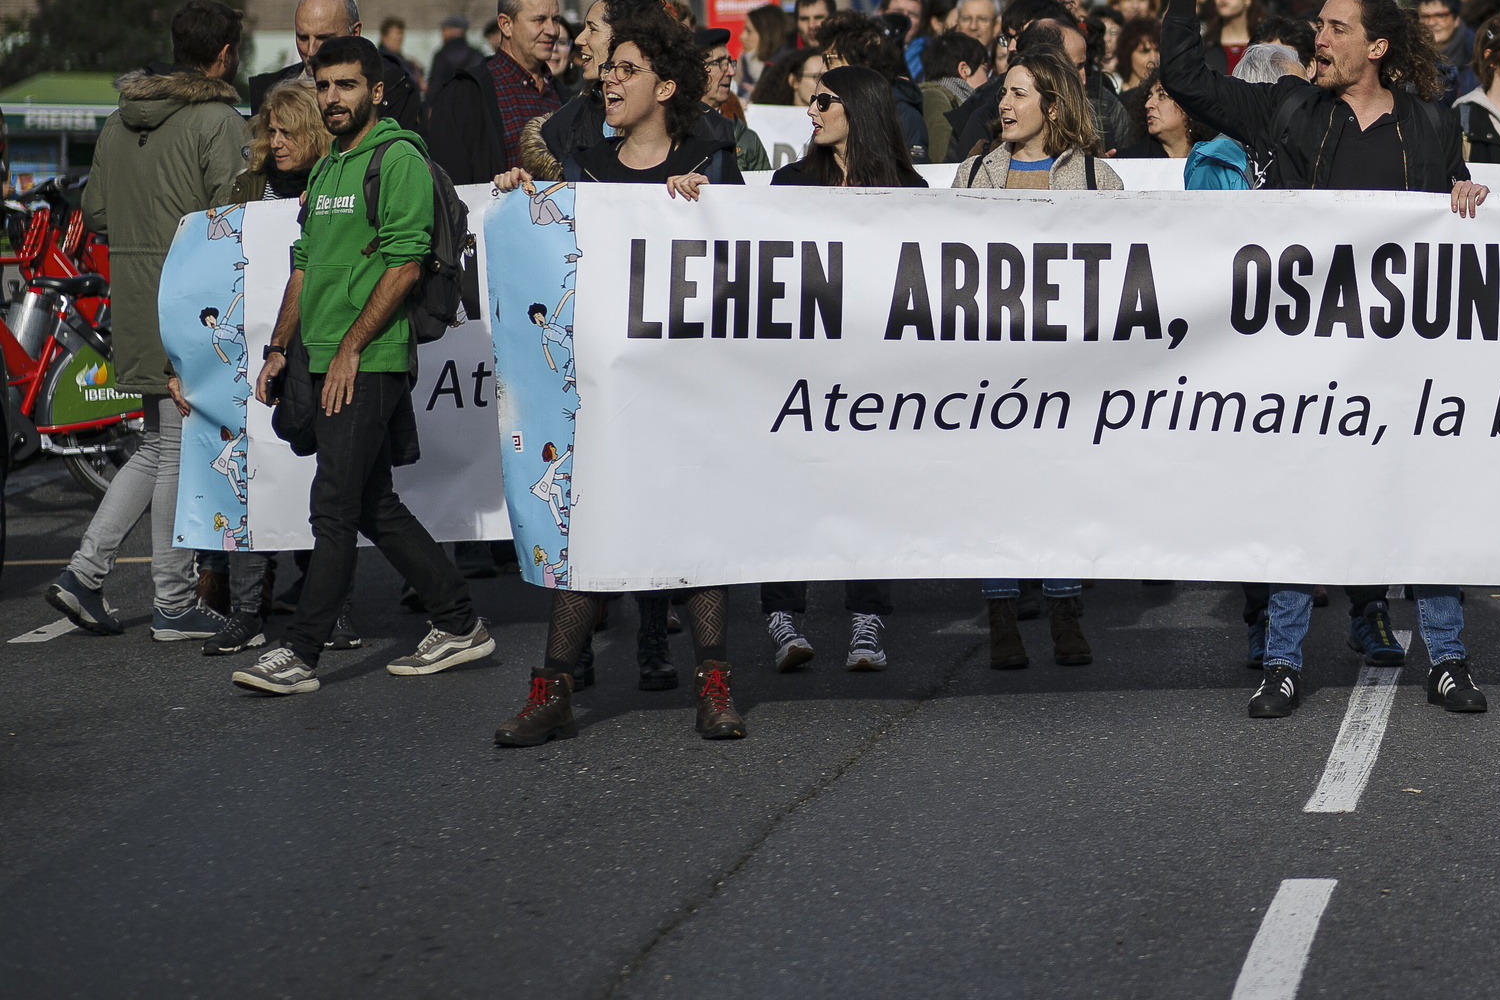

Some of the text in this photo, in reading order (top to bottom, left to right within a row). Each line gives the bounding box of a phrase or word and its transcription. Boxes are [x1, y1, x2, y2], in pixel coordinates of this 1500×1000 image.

[628, 239, 842, 339] LEHEN
[884, 242, 1188, 349] ARRETA,
[1231, 243, 1499, 340] OSASUN
[770, 378, 1070, 432] Atención
[1093, 376, 1387, 445] primaria,
[1414, 379, 1465, 436] la
